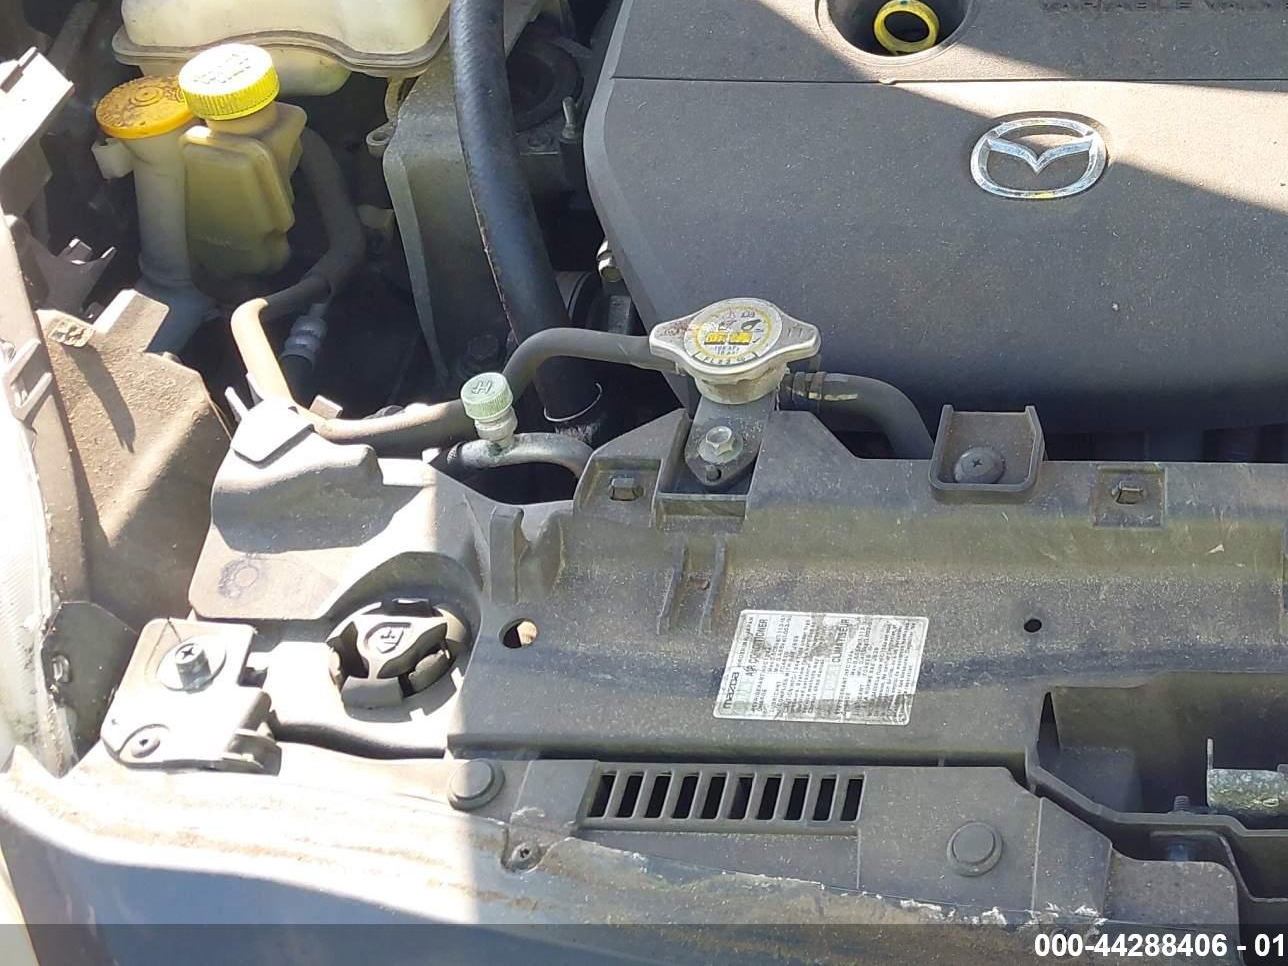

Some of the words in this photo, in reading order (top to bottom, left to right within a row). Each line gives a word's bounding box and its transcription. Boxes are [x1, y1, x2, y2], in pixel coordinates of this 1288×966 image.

[747, 618, 769, 663] CONDITIONER
[831, 618, 850, 662] CLIMATISEUR
[722, 671, 740, 709] mazda
